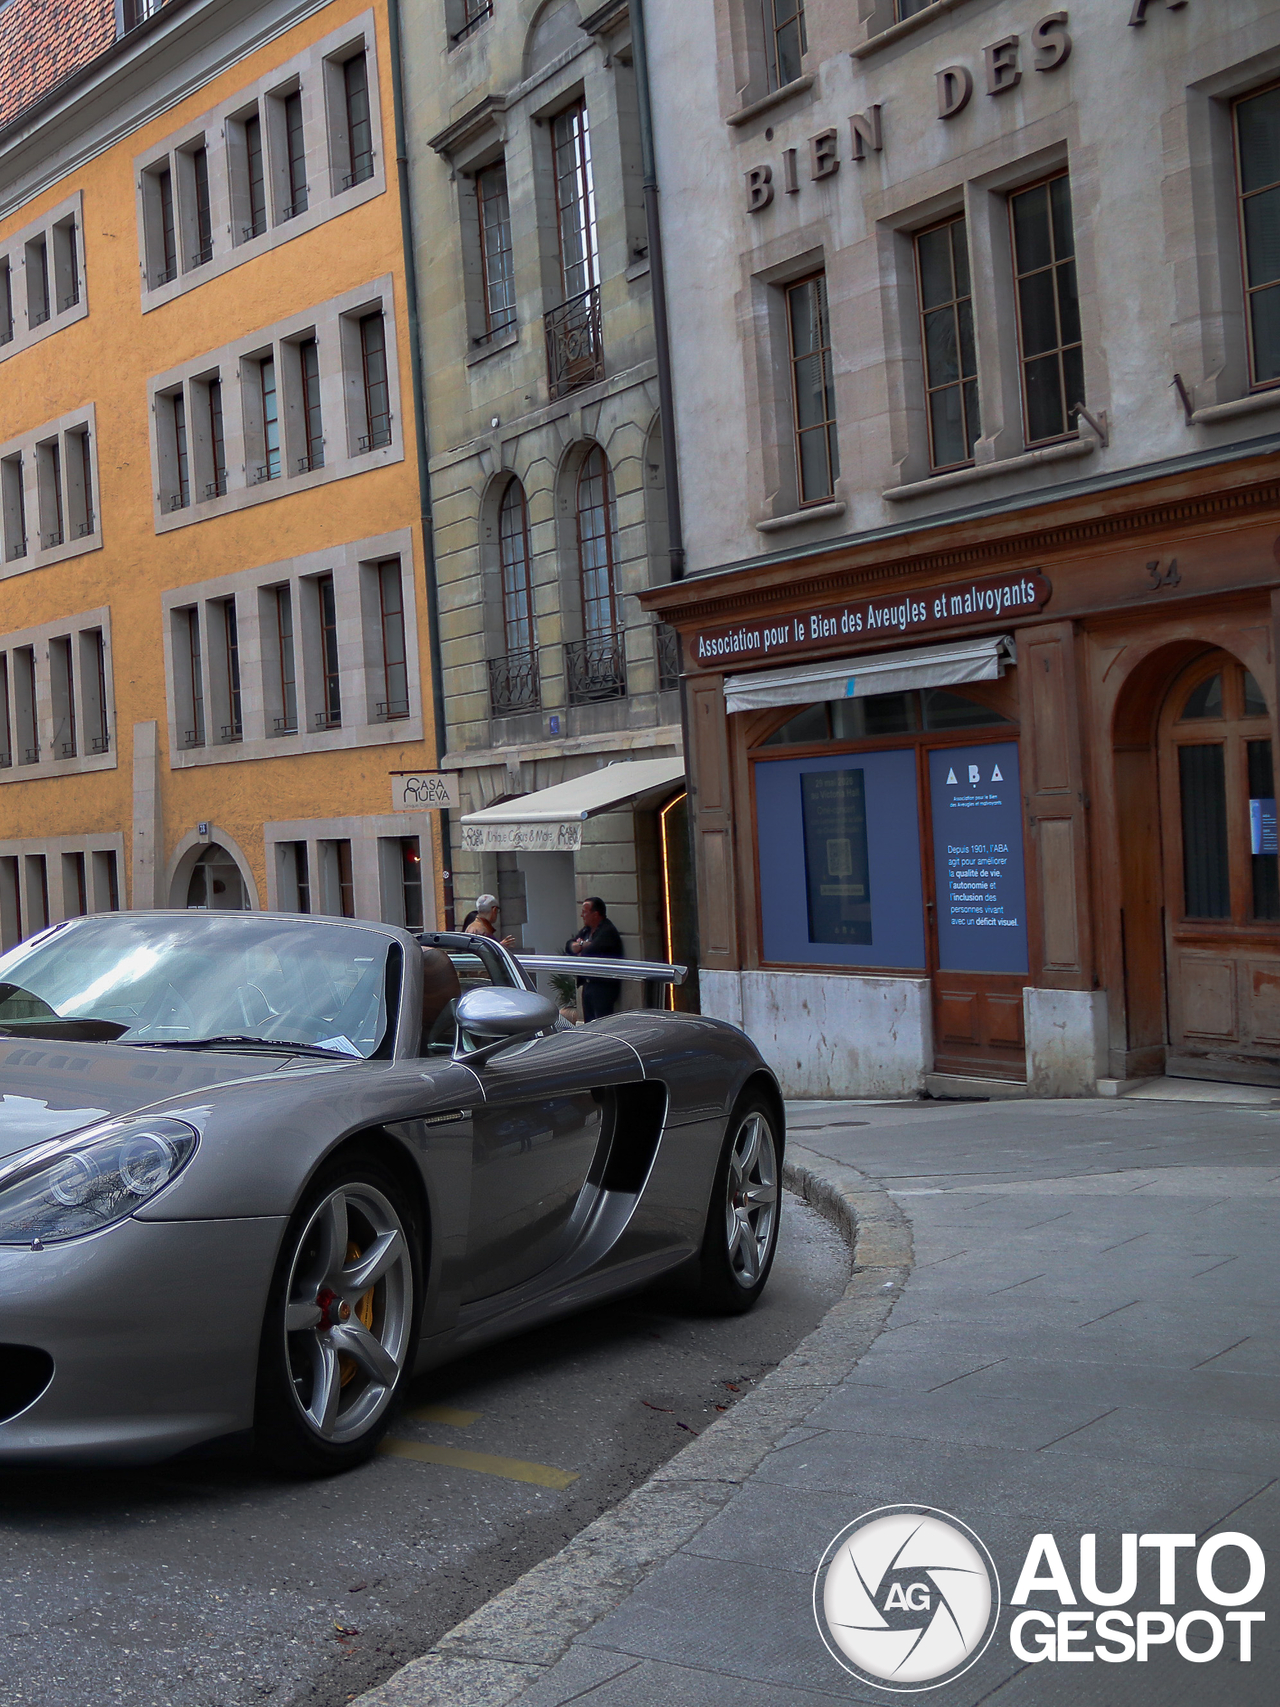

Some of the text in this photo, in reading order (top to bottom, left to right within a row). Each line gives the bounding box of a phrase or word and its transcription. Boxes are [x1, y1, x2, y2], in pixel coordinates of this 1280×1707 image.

[743, 10, 1072, 214] BIEN DES
[1146, 559, 1182, 591] 34
[698, 578, 1035, 658] Association pour le Bien des Aveugles et malvoyants
[947, 845, 970, 855] Depuis
[971, 845, 989, 854] 1901,
[948, 856, 1008, 868] agit pour améliorer
[948, 868, 1003, 879] la qualité de vie,
[949, 881, 997, 890] l'autonomie et
[950, 892, 997, 902] l'inclusion des
[950, 905, 1004, 915] personnes vivant
[967, 918, 975, 926] un
[976, 917, 997, 926] déficit
